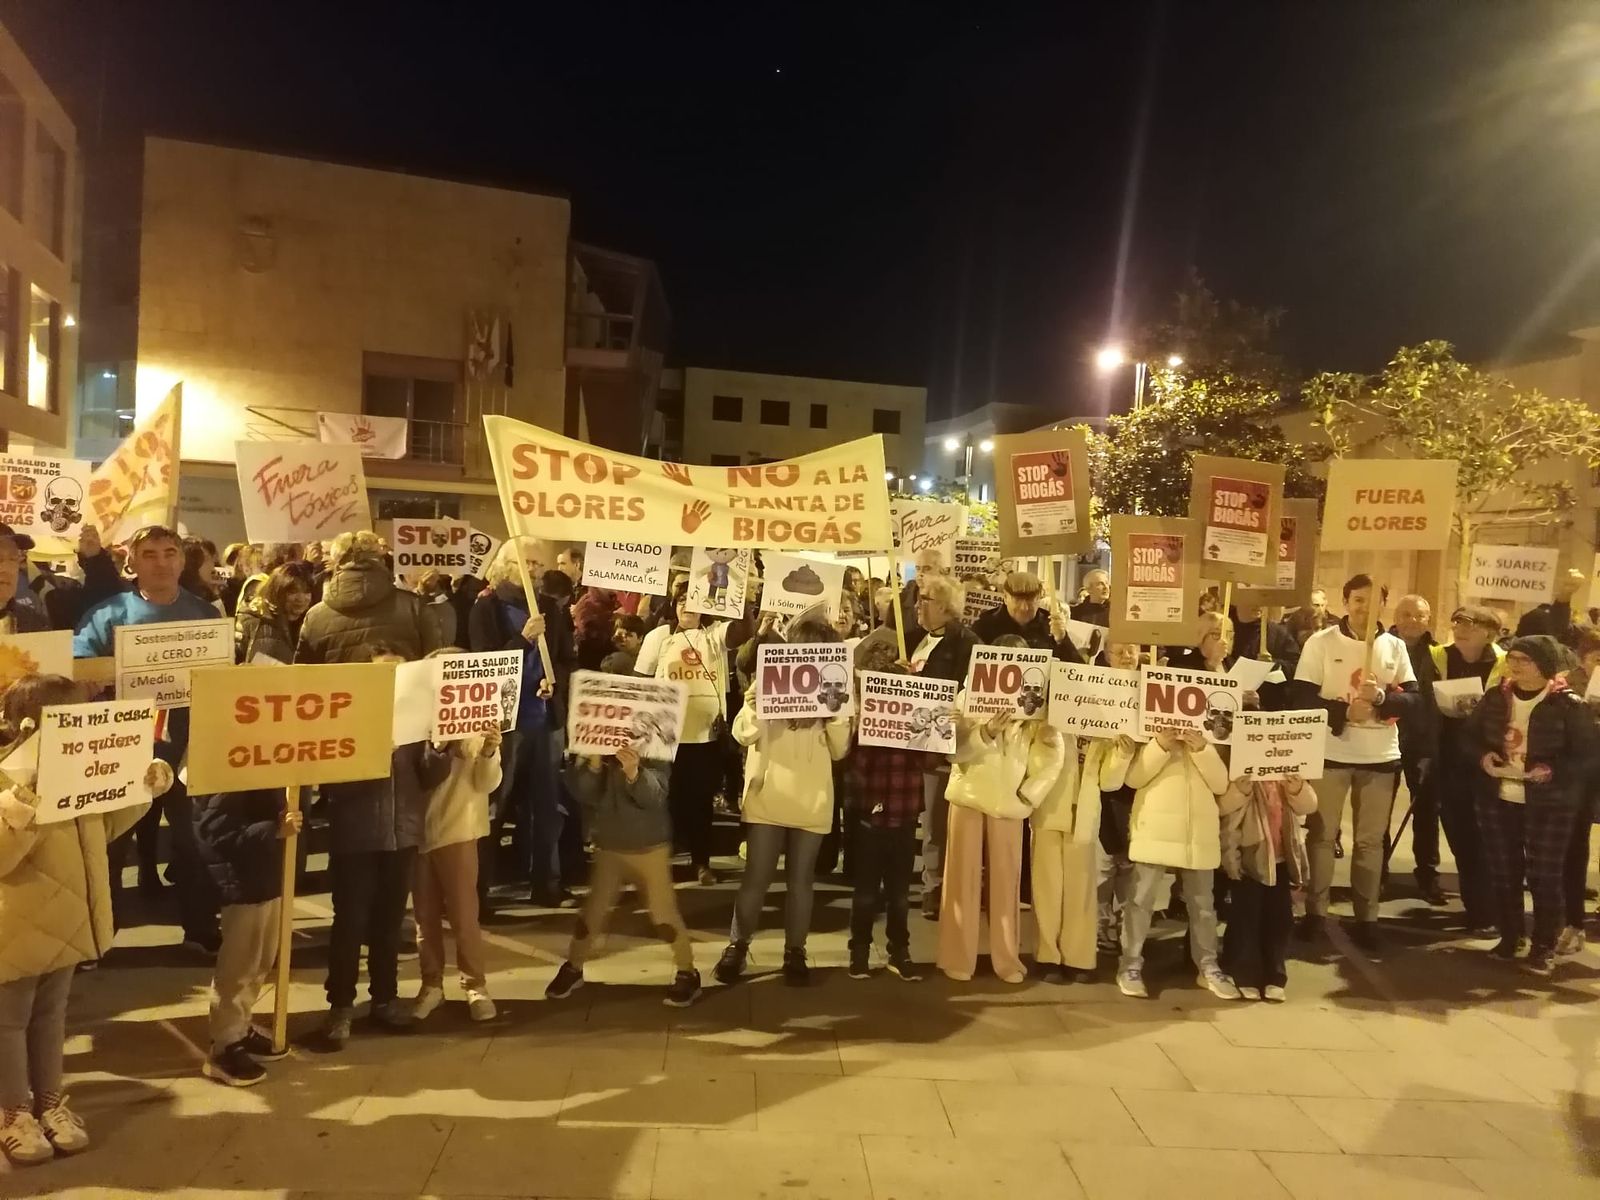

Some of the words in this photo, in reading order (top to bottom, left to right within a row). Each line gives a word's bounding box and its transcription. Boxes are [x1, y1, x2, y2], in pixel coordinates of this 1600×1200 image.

[17, 459, 47, 468] SALUD
[512, 443, 641, 485] STOP
[33, 468, 61, 476] HIJOS
[727, 464, 801, 488] NO
[812, 469, 831, 487] A
[839, 464, 869, 484] LA
[1017, 465, 1049, 483] STOP
[252, 455, 339, 507] Fuera
[1019, 477, 1065, 500] BIOGÁS
[728, 494, 827, 512] PLANTA
[834, 493, 865, 512] DE
[1214, 489, 1248, 507] STOP
[1355, 489, 1425, 505] FUERA
[512, 490, 645, 522] OLORES
[901, 509, 951, 538] Fuera
[1213, 505, 1260, 528] BIOGÁS
[1347, 516, 1427, 531] OLORES
[733, 516, 862, 545] BIOGÁS
[612, 541, 662, 556] LEGADO
[1132, 547, 1163, 565] STOP
[398, 553, 466, 567] OLORES
[615, 558, 639, 569] PARA
[955, 553, 987, 563] STOP
[588, 569, 644, 584] SALAMANCA
[954, 565, 987, 573] OLORES
[1132, 563, 1176, 583] BIOGÁS
[1475, 575, 1547, 591] QUIÑONES
[135, 629, 219, 646] Sostenibilidad:
[162, 648, 193, 660] CERO
[764, 648, 784, 656] POR
[801, 647, 832, 655] SALUD
[764, 655, 816, 664] NUESTROS
[818, 655, 847, 663] HIJOS
[976, 651, 998, 661] POR
[1001, 653, 1014, 662] TU
[1016, 654, 1048, 664] SALUD
[443, 660, 464, 670] POR
[467, 659, 480, 668] LA
[482, 657, 509, 667] SALUD
[511, 656, 519, 665] DE
[443, 668, 495, 680] NUESTROS
[497, 666, 519, 677] HIJOS
[668, 667, 718, 682] olores
[762, 664, 820, 695] NO
[971, 663, 1022, 695] NO
[1087, 673, 1105, 684] mi
[1108, 677, 1139, 688] casa
[1146, 671, 1172, 682] POR
[1175, 674, 1192, 683] TU
[1196, 676, 1238, 688] SALUD
[866, 676, 887, 686] POR
[890, 679, 903, 688] LA
[905, 680, 939, 692] SALUD
[941, 685, 955, 694] DE
[440, 682, 498, 705] STOP
[771, 696, 809, 705] PLANTA
[865, 685, 920, 699] NUESTROS
[922, 691, 954, 703] HIJOS
[977, 697, 1010, 706] PLANTA
[1054, 692, 1070, 702] no
[1074, 694, 1116, 707] quiero
[1145, 683, 1207, 717] NO
[234, 692, 353, 725] STOP
[438, 703, 498, 722] OLORES
[763, 704, 818, 714] BIOMETANO
[864, 698, 914, 716] STOP
[88, 708, 109, 726] mi
[862, 717, 912, 731] OLORES
[1067, 715, 1077, 725] a
[1154, 716, 1193, 728] PLANTA
[1266, 715, 1285, 725] mi
[437, 718, 498, 736] TÓXICOS
[61, 740, 84, 755] no
[88, 733, 141, 754] quiero
[1247, 733, 1264, 742] no
[1268, 731, 1313, 744] quiero
[228, 737, 356, 769] OLORES
[84, 760, 120, 778] oler
[1244, 766, 1254, 775] a
[57, 795, 71, 809] a
